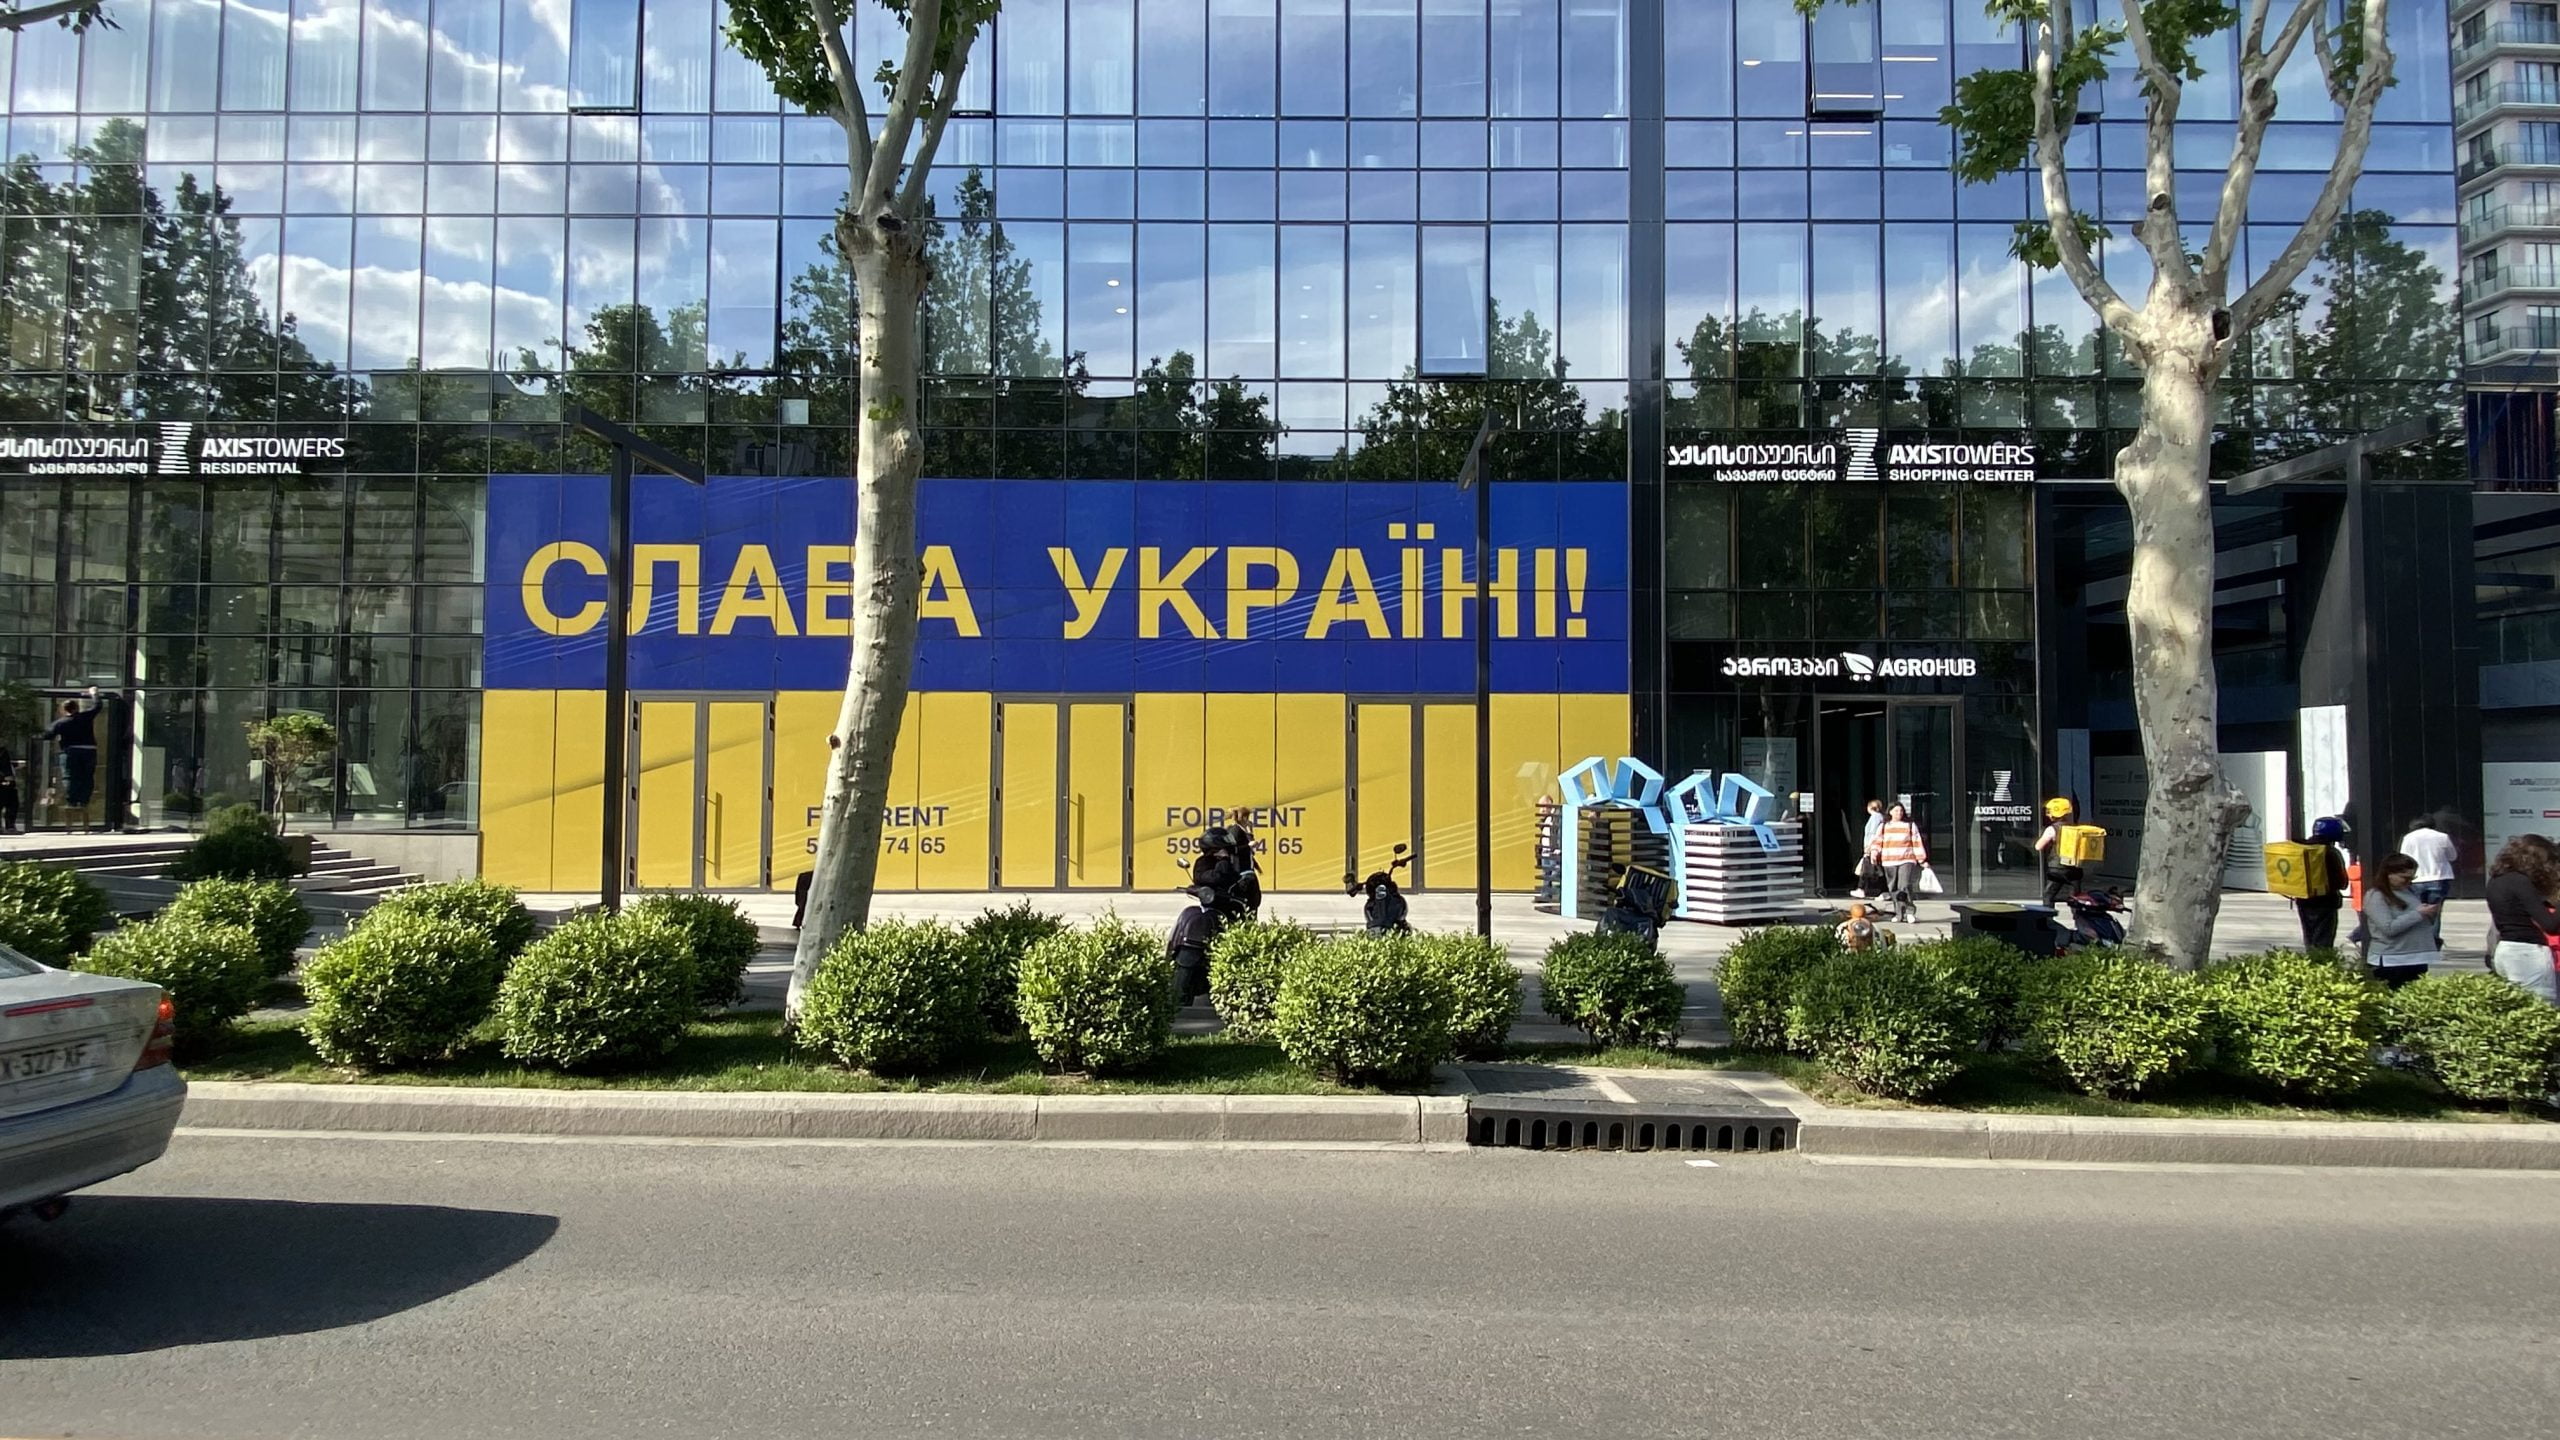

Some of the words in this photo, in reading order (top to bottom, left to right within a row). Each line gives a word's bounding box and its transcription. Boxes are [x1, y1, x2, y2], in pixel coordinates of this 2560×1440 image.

[0, 437, 149, 458] ქსისთაუერსი
[201, 438, 345, 458] AXISTOWERS
[1667, 445, 1836, 466] აქსისთაუერსი
[1889, 445, 2035, 465] AXISTOWERS
[201, 462, 301, 475] RESIDENTIAL
[1781, 469, 1836, 482] ცენტრი
[1889, 468, 1970, 482] SHOPPING
[1973, 468, 2035, 482] CENTER
[1046, 522, 1588, 641] УКРАЇНІ!
[1878, 657, 1977, 677] AGROHUB
[1166, 806, 1225, 828] FOR
[1252, 806, 1306, 828] ENT
[1973, 805, 2032, 815] AXISTOWERS
[884, 837, 909, 854] 74
[920, 837, 945, 854] 65
[1278, 837, 1303, 855] 65
[0, 1042, 88, 1081] X-327-XF
